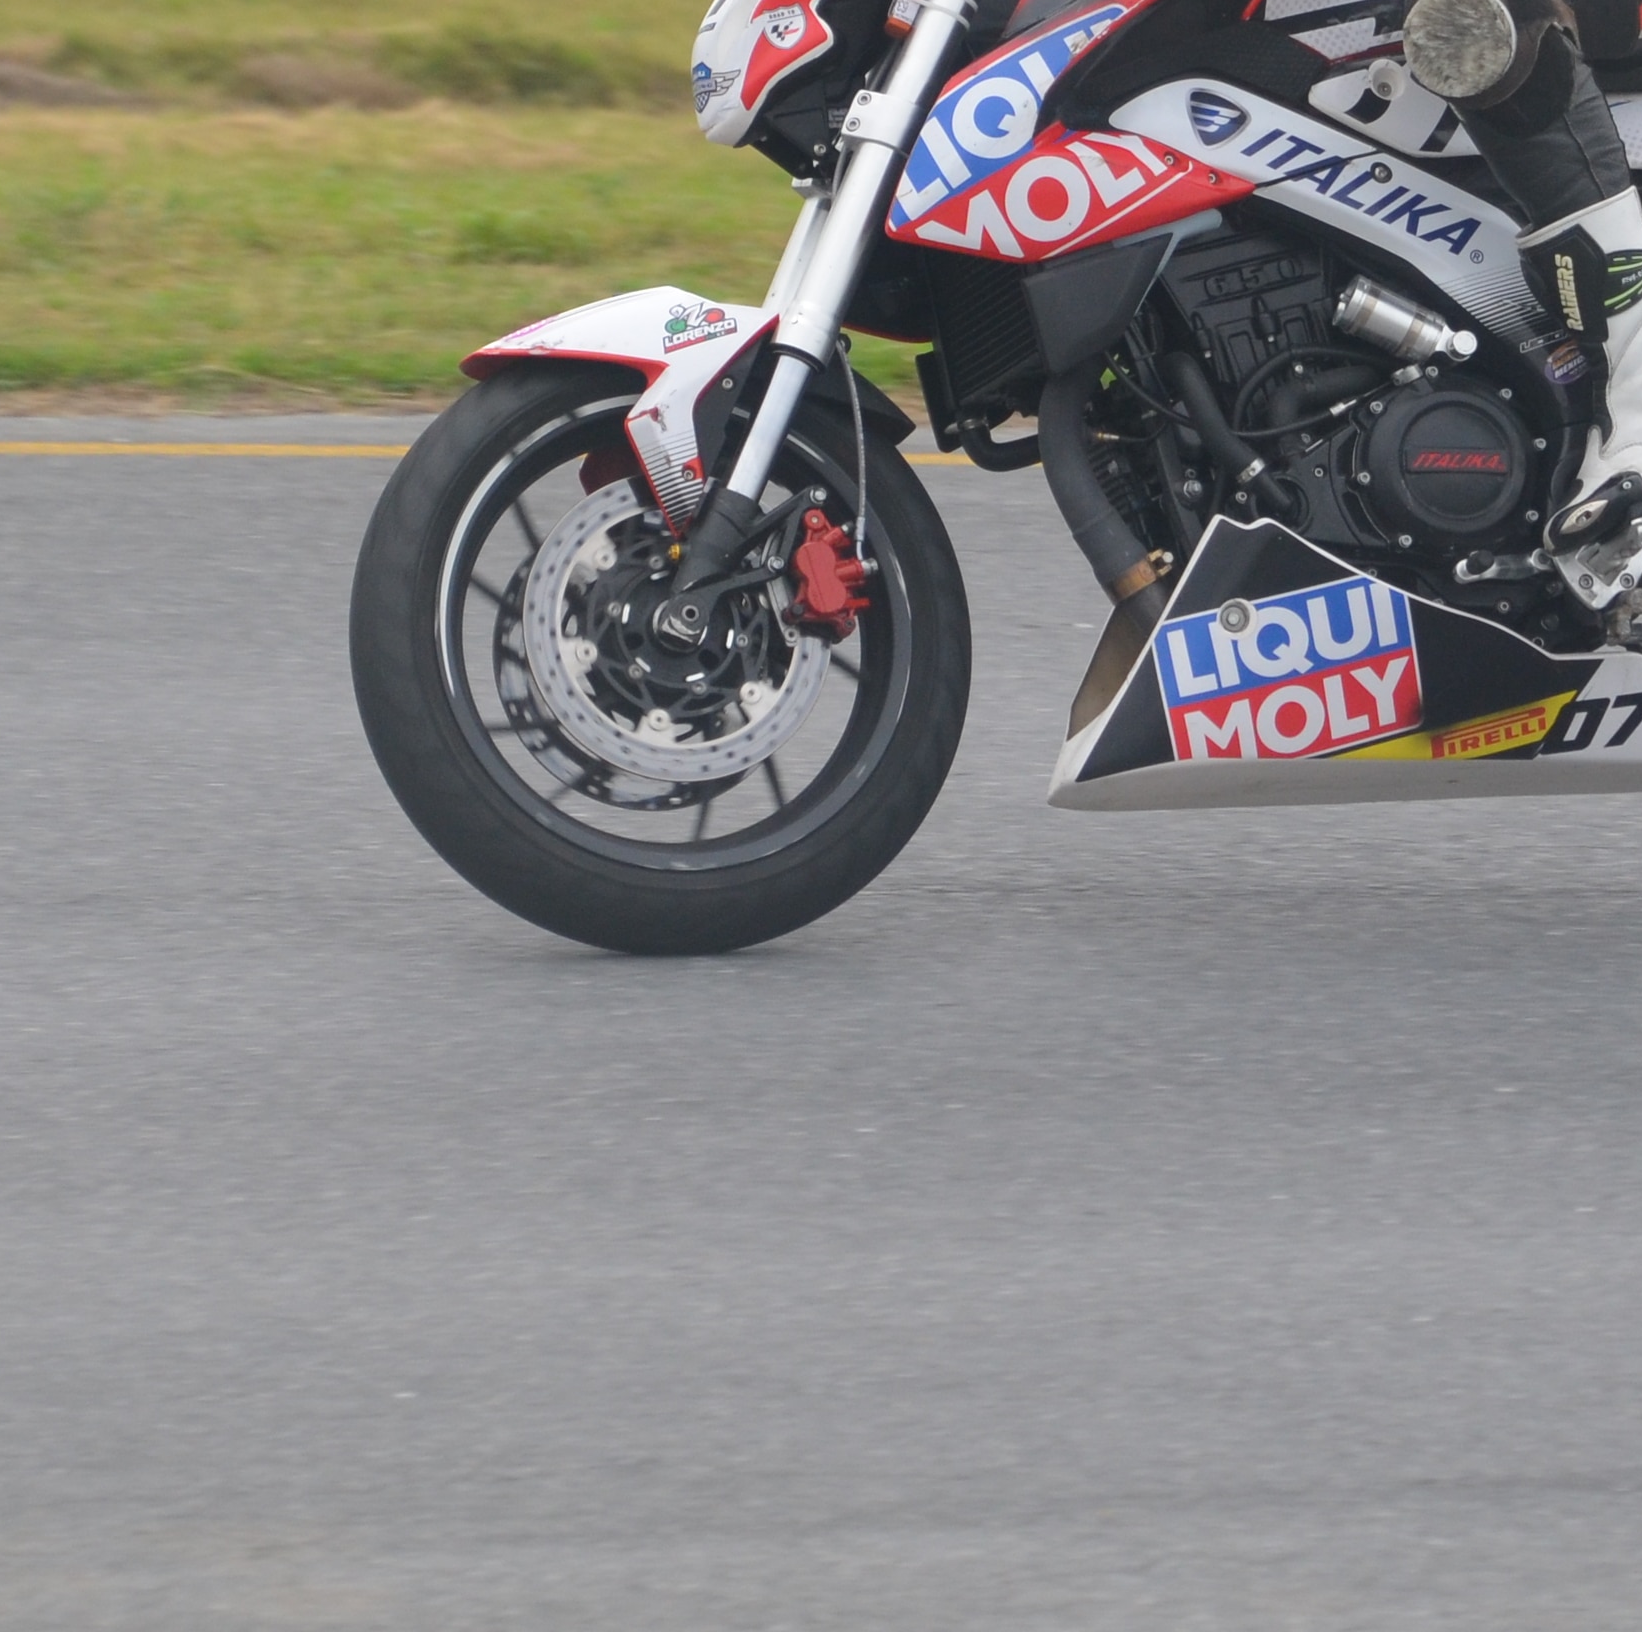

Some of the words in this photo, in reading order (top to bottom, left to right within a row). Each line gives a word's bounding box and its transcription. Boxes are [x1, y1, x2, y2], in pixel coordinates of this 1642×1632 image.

[896, 18, 1112, 221] LIQ
[914, 131, 1168, 259] MOLY
[1240, 128, 1482, 255] ITALIKA
[1205, 259, 1303, 298] 650
[664, 318, 736, 348] LORENZO
[1412, 451, 1504, 470] ITALIKA
[1166, 582, 1398, 698] LIQUI
[1184, 655, 1410, 759] MOLY
[1431, 706, 1547, 759] PIRELLI
